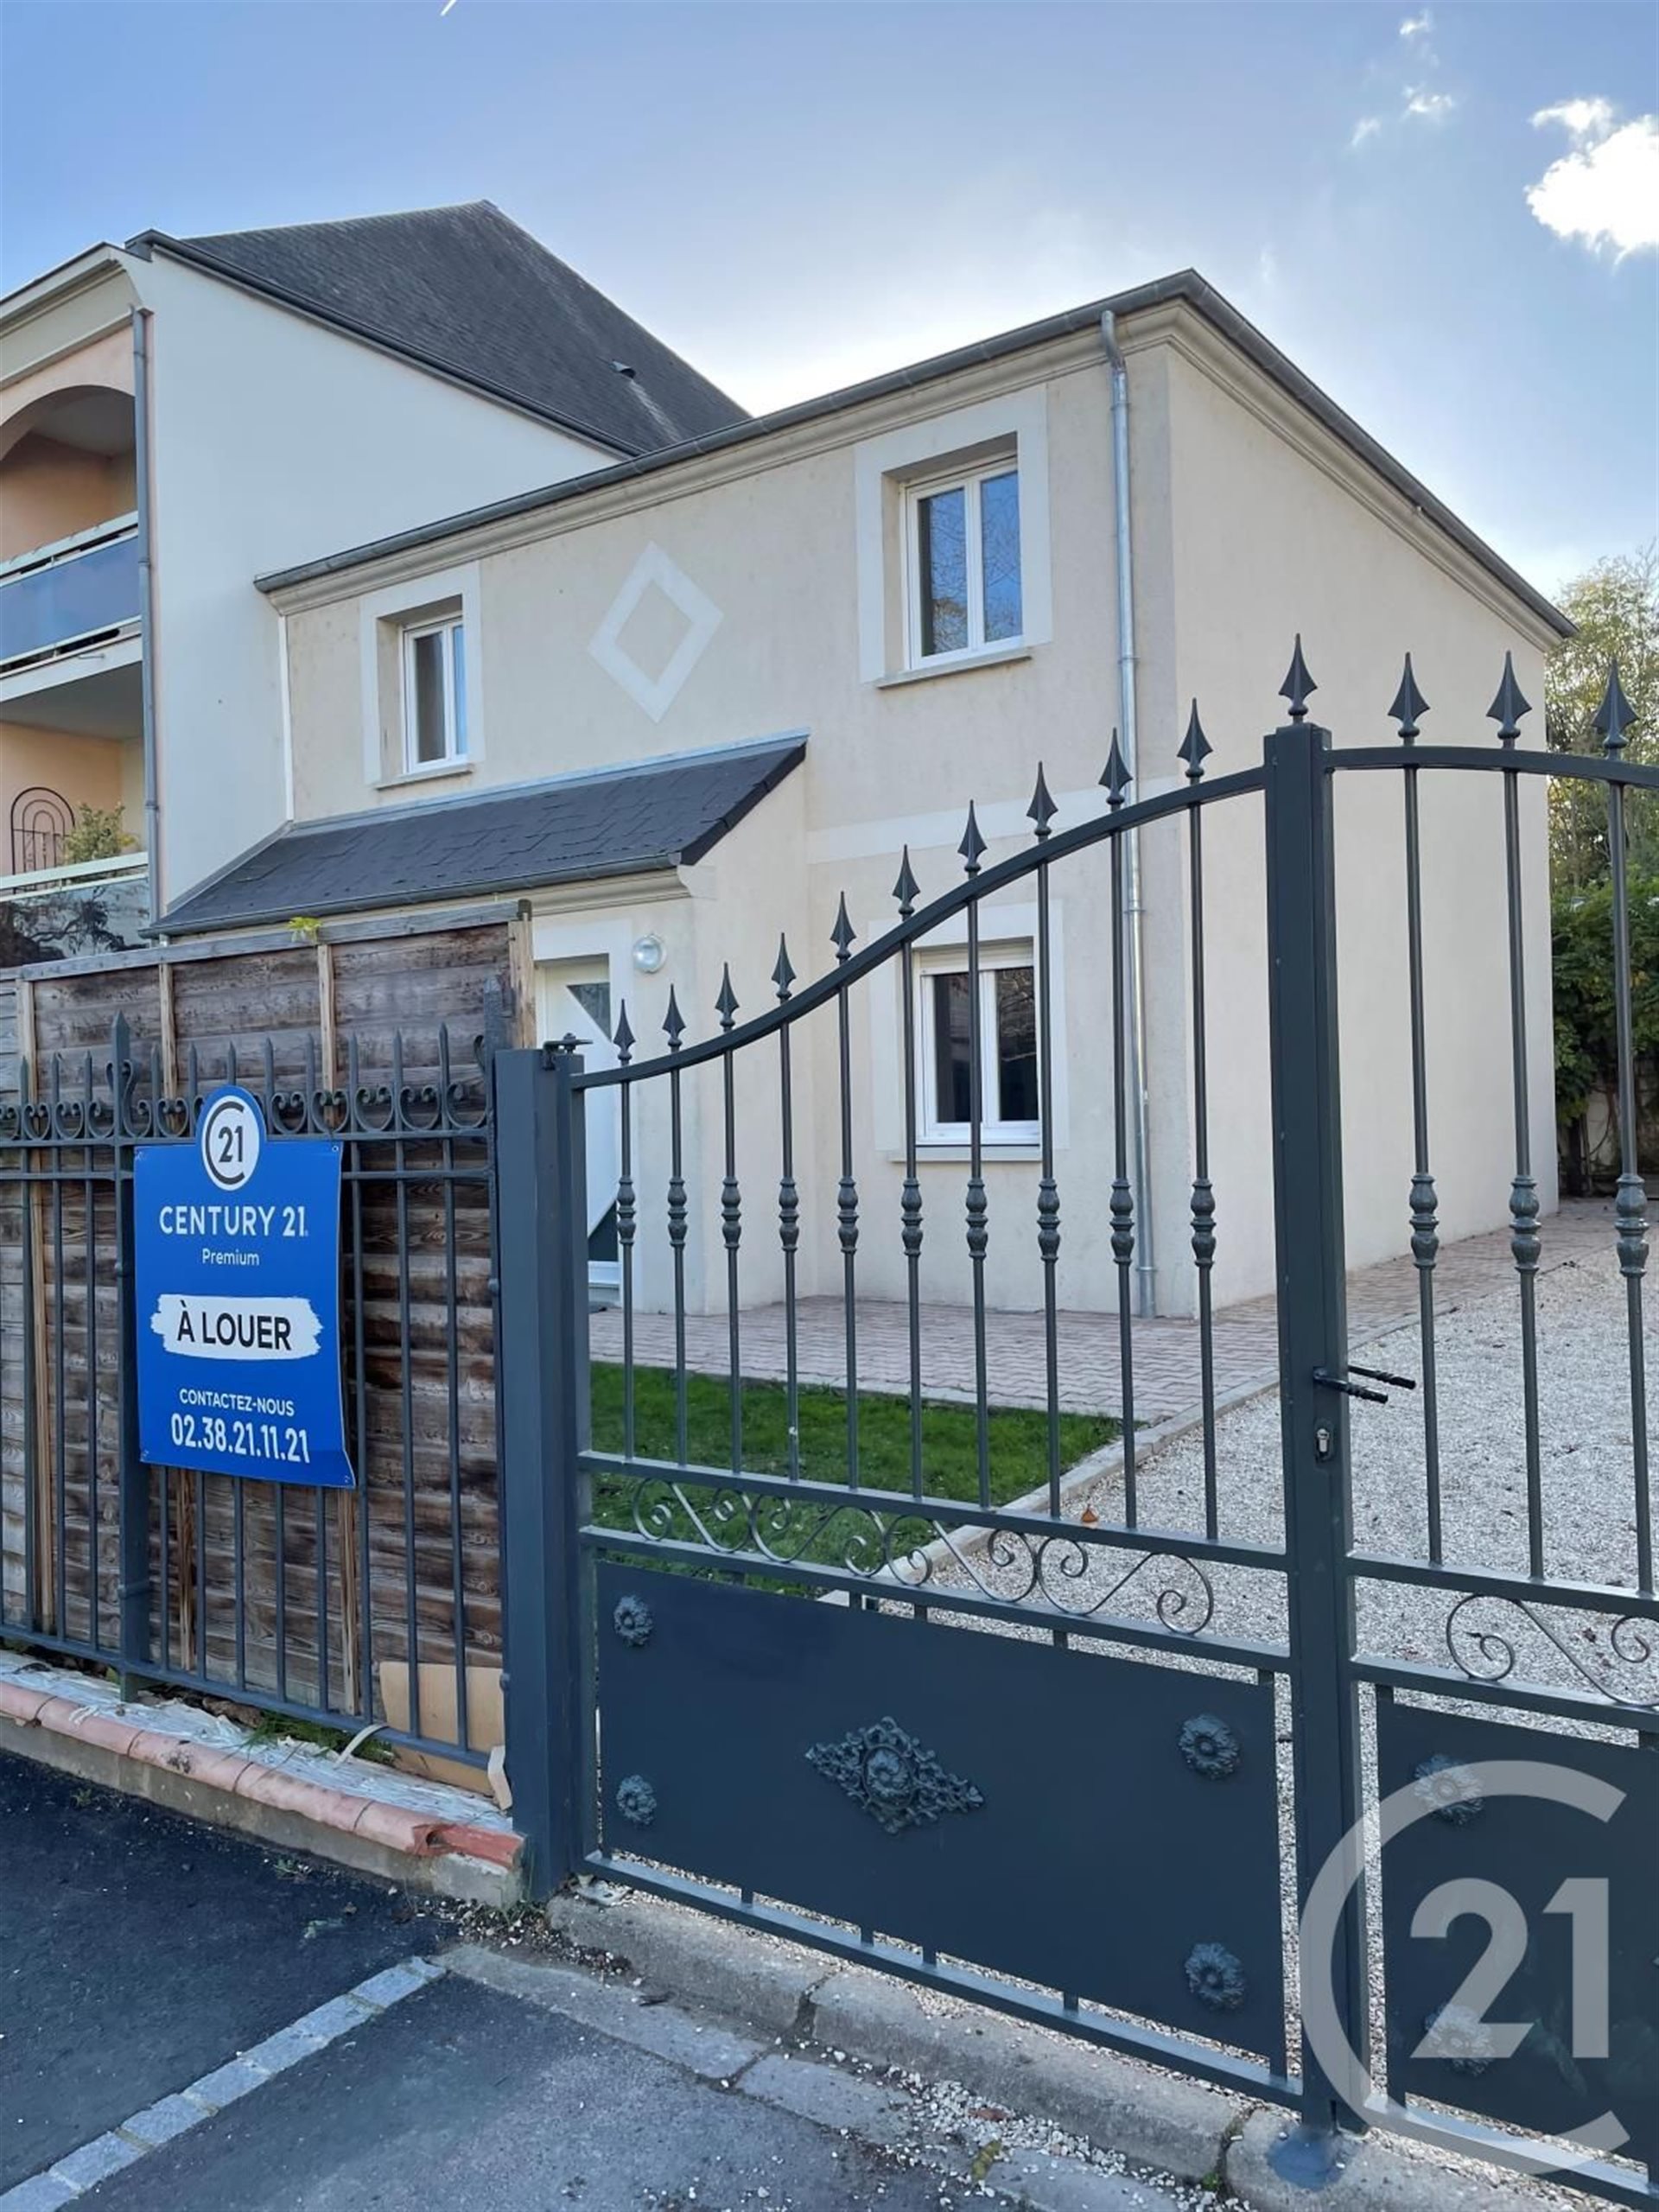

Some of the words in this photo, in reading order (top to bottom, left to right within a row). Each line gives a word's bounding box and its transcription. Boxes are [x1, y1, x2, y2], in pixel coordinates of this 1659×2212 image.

[159, 1205, 276, 1236] CENTURY
[282, 1205, 305, 1237] 21
[202, 1248, 260, 1266] Premium
[177, 1299, 195, 1343] À
[202, 1311, 292, 1351] LOUER
[179, 1388, 296, 1417] CONTACTEZ-NOUS
[171, 1412, 311, 1464] 02.38.21.11.21
